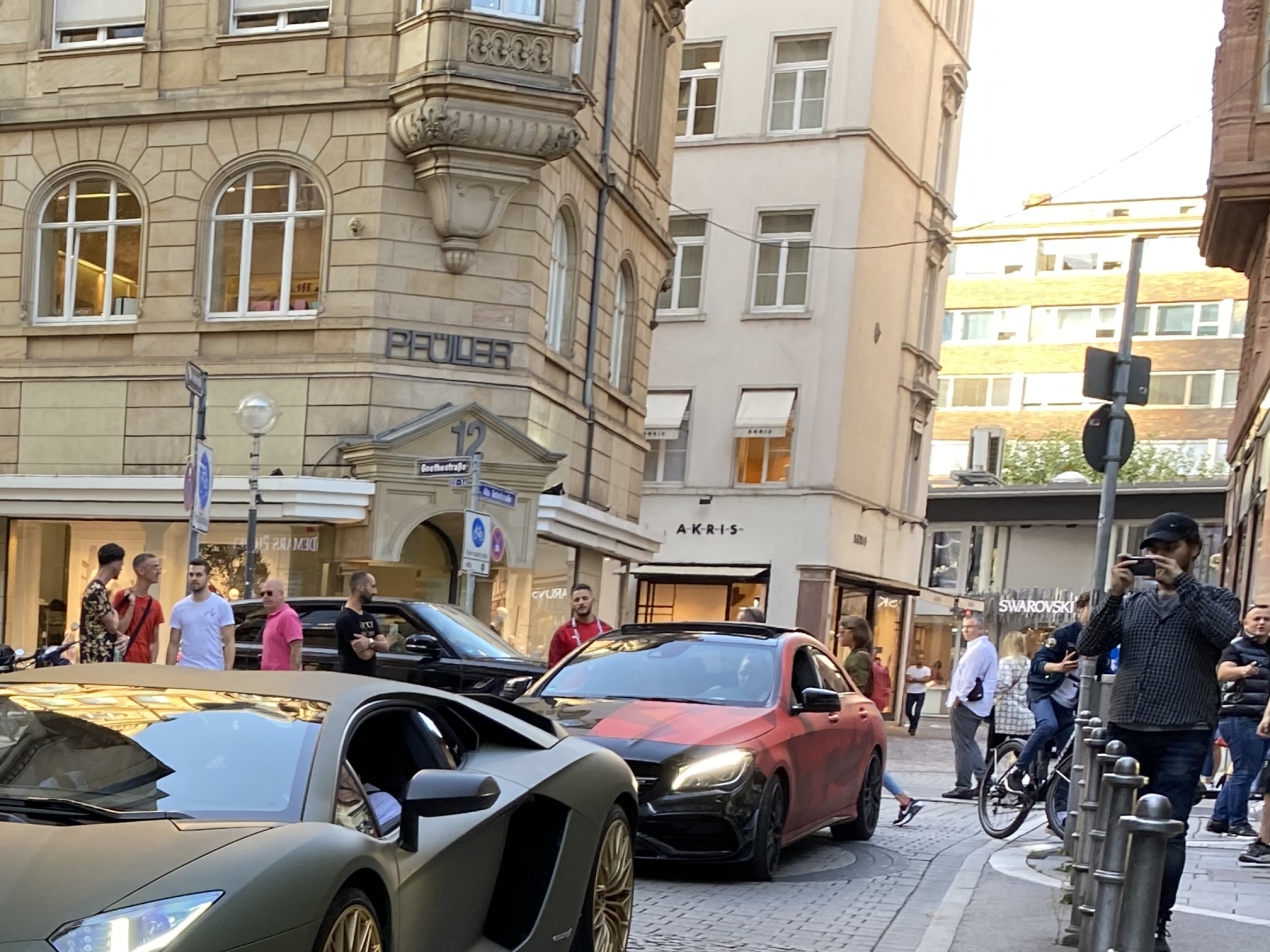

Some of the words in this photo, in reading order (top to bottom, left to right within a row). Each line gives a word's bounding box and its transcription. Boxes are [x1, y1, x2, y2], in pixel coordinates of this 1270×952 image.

[385, 327, 513, 370] PFÜLLER
[451, 420, 487, 457] 12
[420, 462, 467, 473] Goethestraße
[998, 599, 1076, 614] SWAROVSKI
